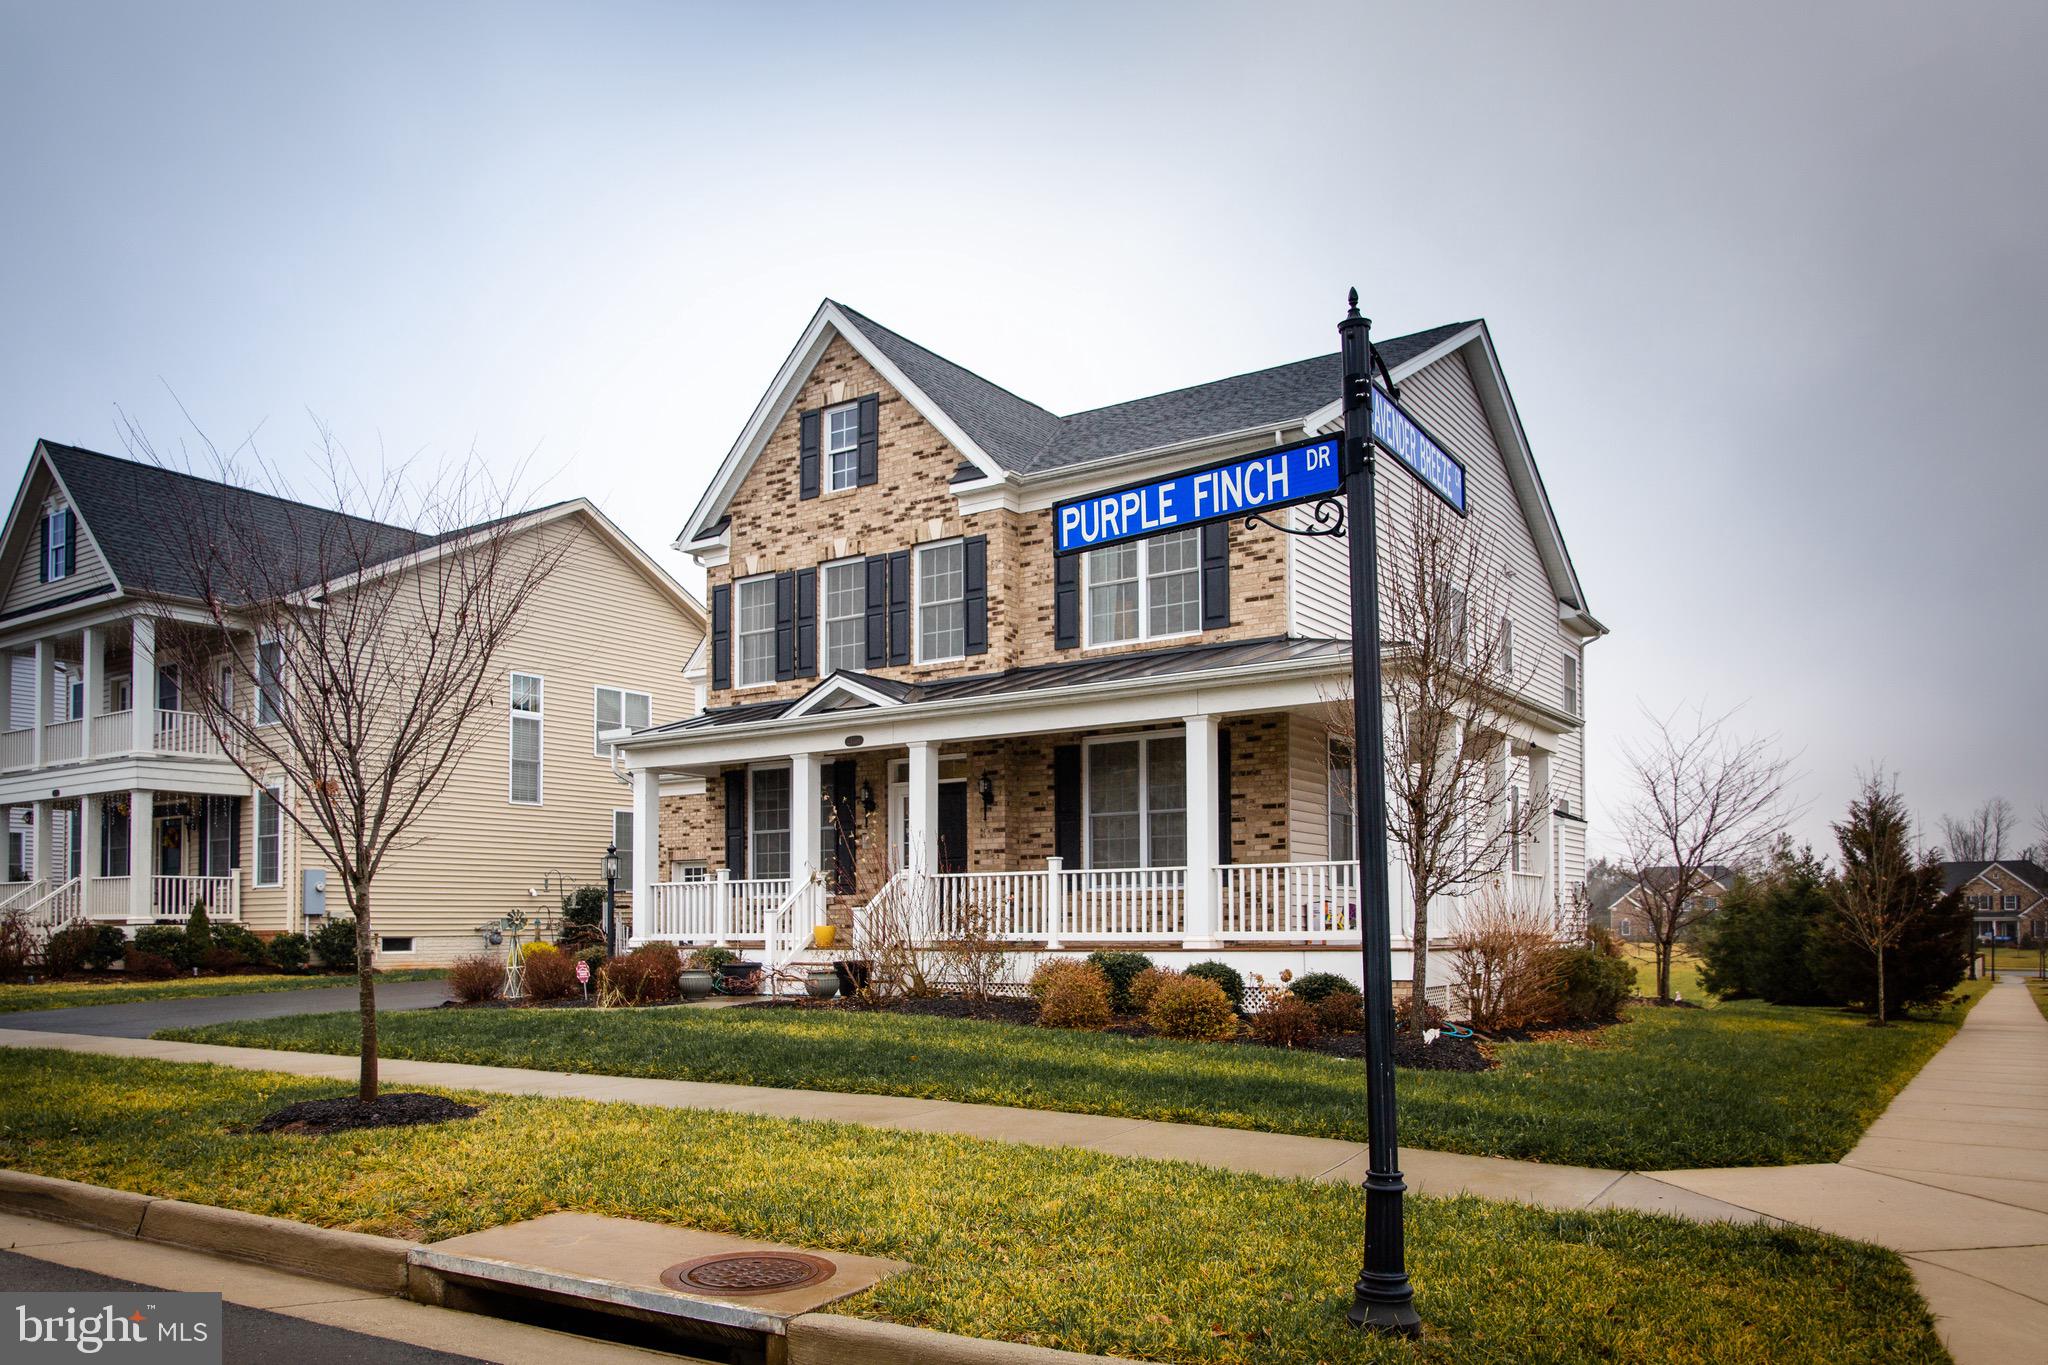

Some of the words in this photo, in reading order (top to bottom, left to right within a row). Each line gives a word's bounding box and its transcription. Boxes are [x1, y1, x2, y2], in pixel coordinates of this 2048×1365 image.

[1062, 482, 1178, 547] PURPLE
[1193, 455, 1289, 518] FINCH
[1306, 445, 1331, 471] DR
[1371, 392, 1417, 468] AVENDER
[1420, 435, 1453, 499] BREEZE
